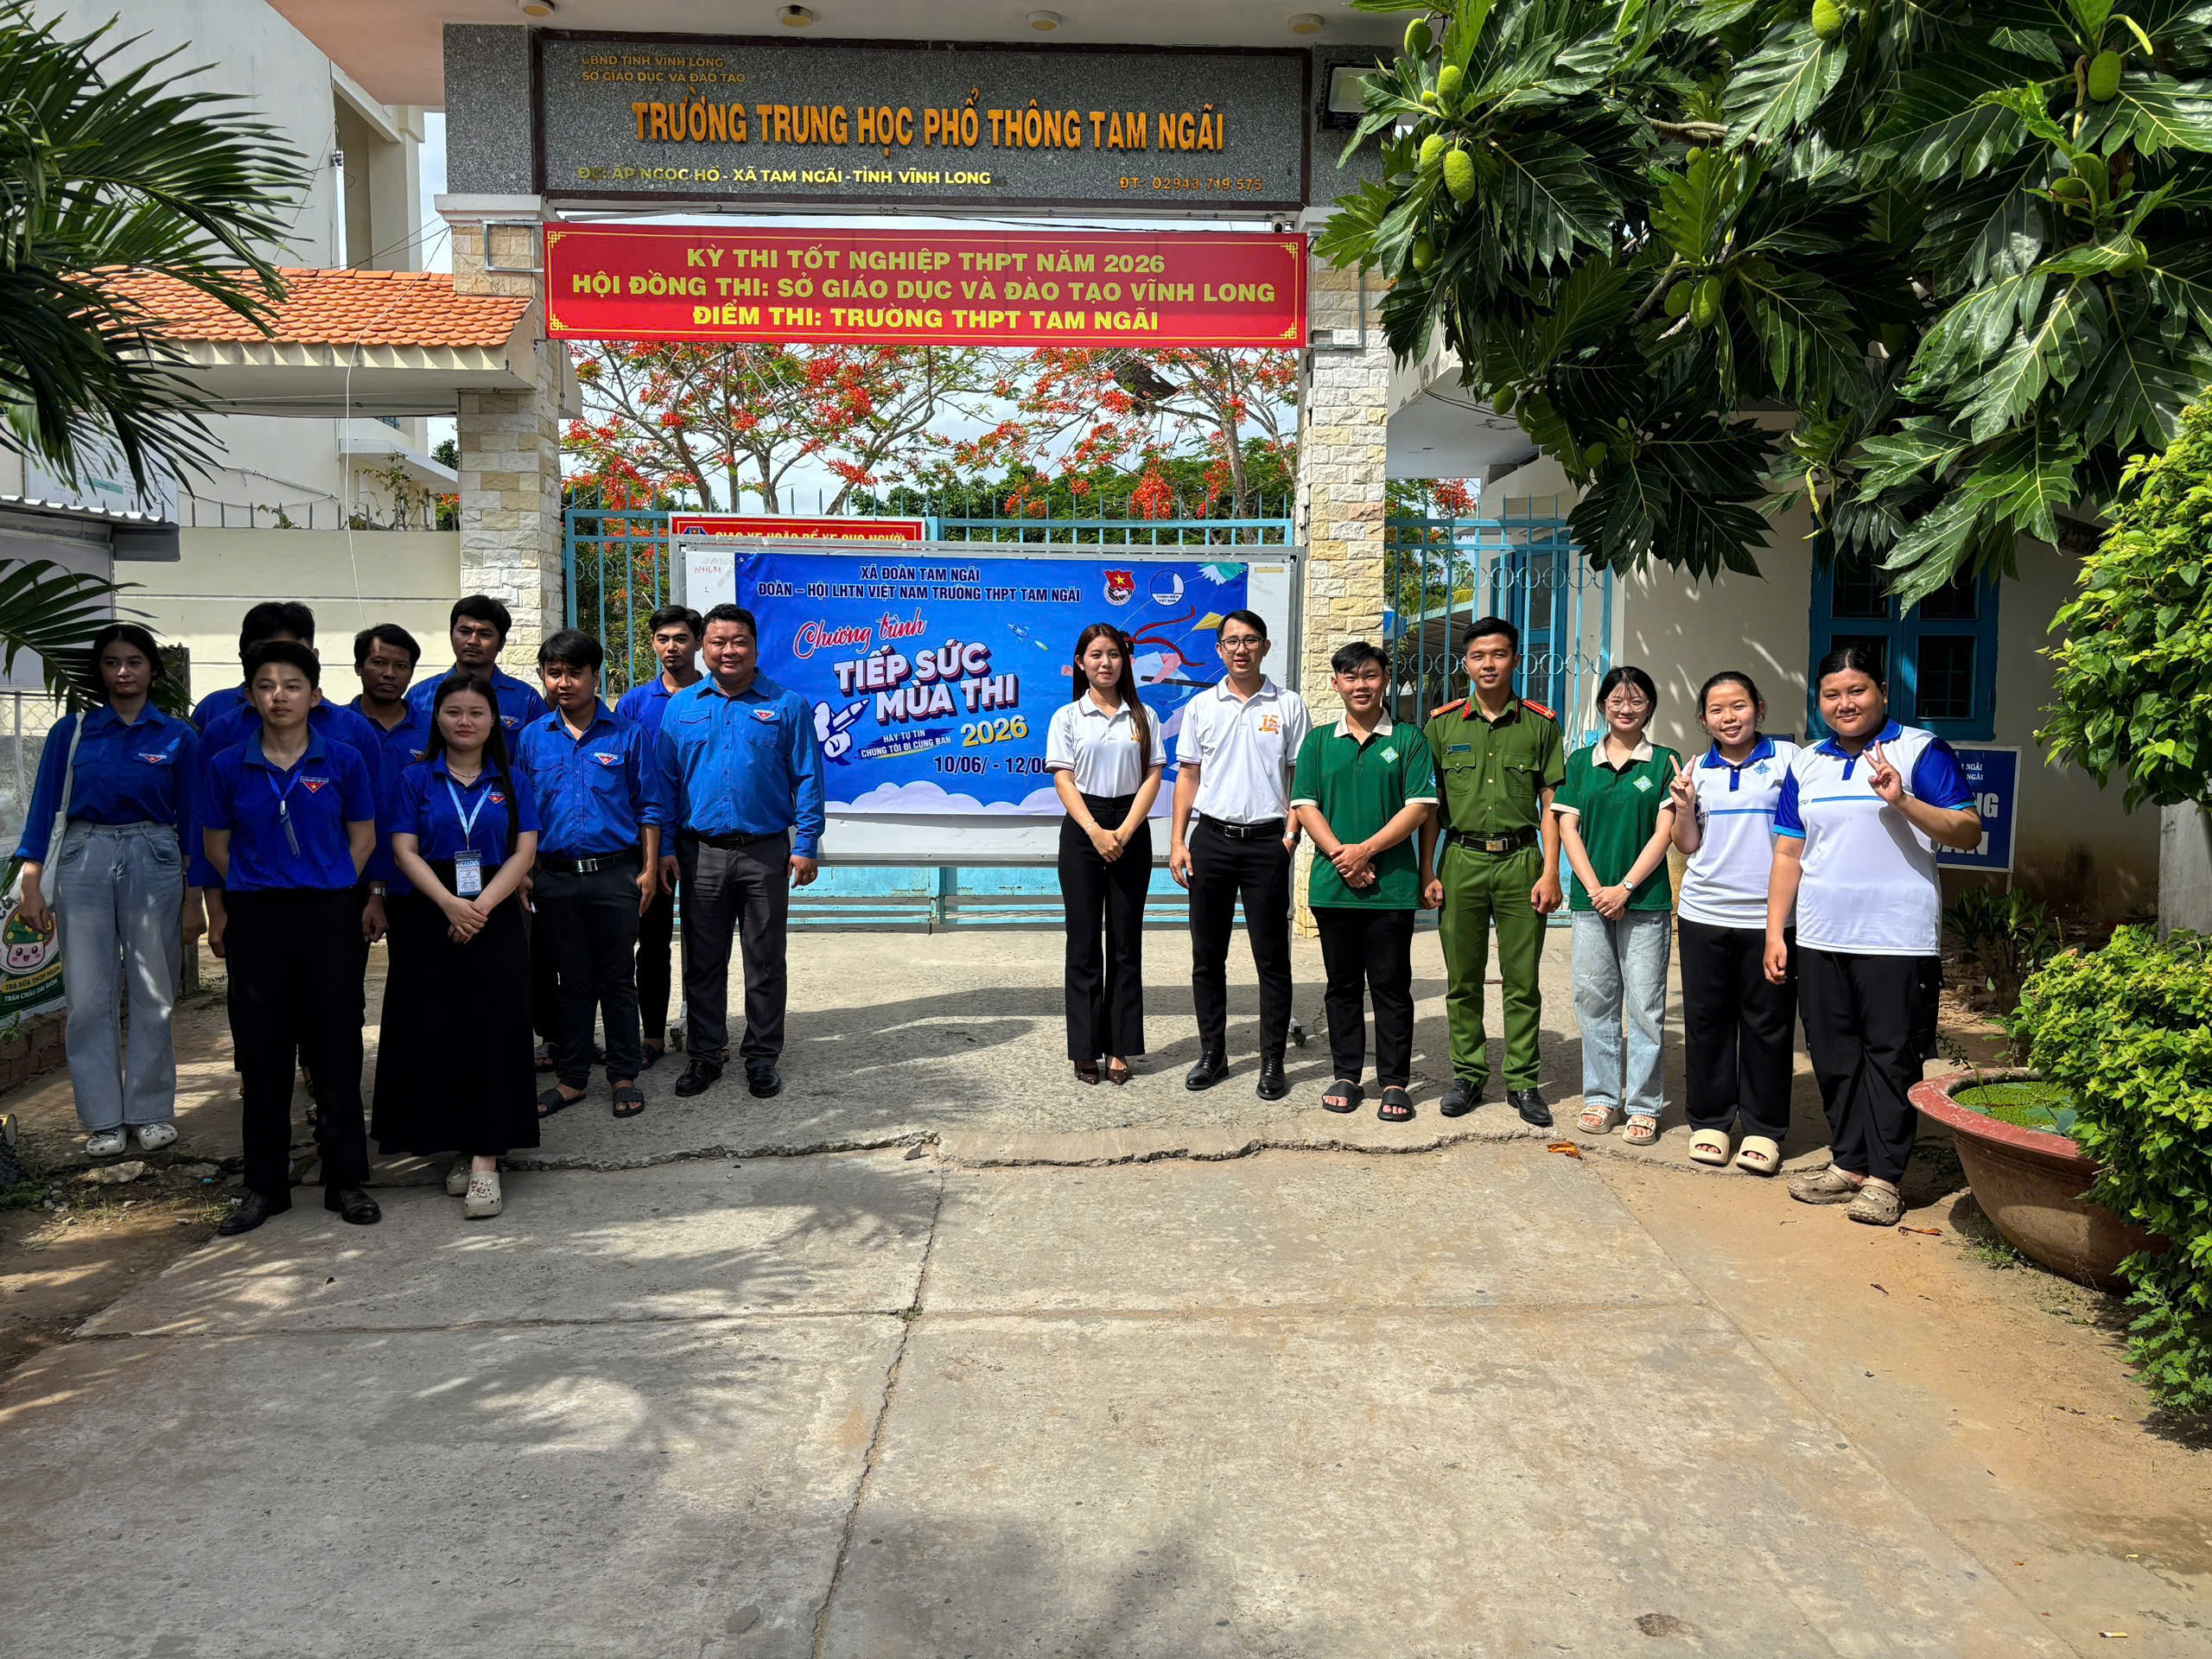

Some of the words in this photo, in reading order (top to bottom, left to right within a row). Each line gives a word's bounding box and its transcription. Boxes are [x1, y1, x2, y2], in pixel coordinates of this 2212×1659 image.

[690, 57, 723, 67] LONG
[632, 86, 747, 143] TRƯỜNG
[756, 104, 849, 145] TRUNG
[857, 105, 913, 156] HỌC
[924, 86, 980, 147] PHỔ
[988, 99, 1081, 149] THÔNG
[1089, 111, 1147, 149] TAM
[1158, 104, 1225, 151] NGÃI
[640, 167, 690, 186] NGỌC
[733, 165, 757, 181] XÃ
[760, 169, 797, 183] TAM
[802, 167, 842, 183] NGÃI
[853, 165, 893, 183] TỈNH
[899, 167, 940, 184] VĨNH
[945, 171, 991, 185] LONG
[1120, 177, 1146, 189] ĐT:
[1152, 177, 1200, 190] 02943
[1206, 178, 1230, 190] 719
[1236, 179, 1263, 191] 575
[688, 243, 725, 268] KỲ
[734, 249, 778, 268] THI
[786, 243, 841, 269] TỐT
[849, 247, 950, 275] NGHIỆP
[958, 251, 1027, 272] THPT
[1037, 249, 1095, 273] NĂM
[1104, 254, 1165, 274] 2026
[573, 270, 620, 297] HỘI
[629, 270, 706, 296] ĐỒNG
[715, 277, 768, 297] THI:
[778, 271, 813, 298] SỞ
[822, 274, 887, 300] GIÁO
[897, 281, 952, 303] DỤC
[961, 276, 996, 300] VÀ
[1003, 276, 1060, 302] ĐÀO
[1068, 282, 1122, 304] TẠO
[1129, 278, 1194, 302] VĨNH
[1204, 283, 1275, 302] LONG
[693, 299, 759, 325] ĐIỂM
[768, 307, 821, 326] THI:
[830, 302, 942, 327] TRƯỜNG
[951, 309, 1021, 328] THPT
[1029, 311, 1085, 329] TAM
[1095, 307, 1158, 330] NGÃI
[861, 563, 878, 580] XÃ
[881, 564, 915, 581] ĐOÀN
[919, 568, 947, 581] TAM
[951, 566, 980, 582] NGÃI
[758, 581, 792, 596] ĐOÀN
[807, 581, 830, 600] HỘI
[832, 584, 865, 598] LHTN
[868, 583, 896, 601] VIỆT
[899, 587, 928, 600] NAM
[931, 585, 981, 601] TRƯỜNG
[985, 588, 1016, 601] THPT
[1021, 588, 1048, 602] TAM
[1051, 588, 1080, 602] NGÃI
[794, 620, 873, 659] Chương
[876, 607, 927, 640] trình
[833, 645, 911, 693] TIẾP
[914, 639, 991, 681] SỨC
[876, 677, 957, 724] MÙA
[960, 672, 1018, 712] THI
[912, 729, 925, 738] TIN
[961, 715, 1028, 747] 2026
[935, 756, 988, 775] 10/06/
